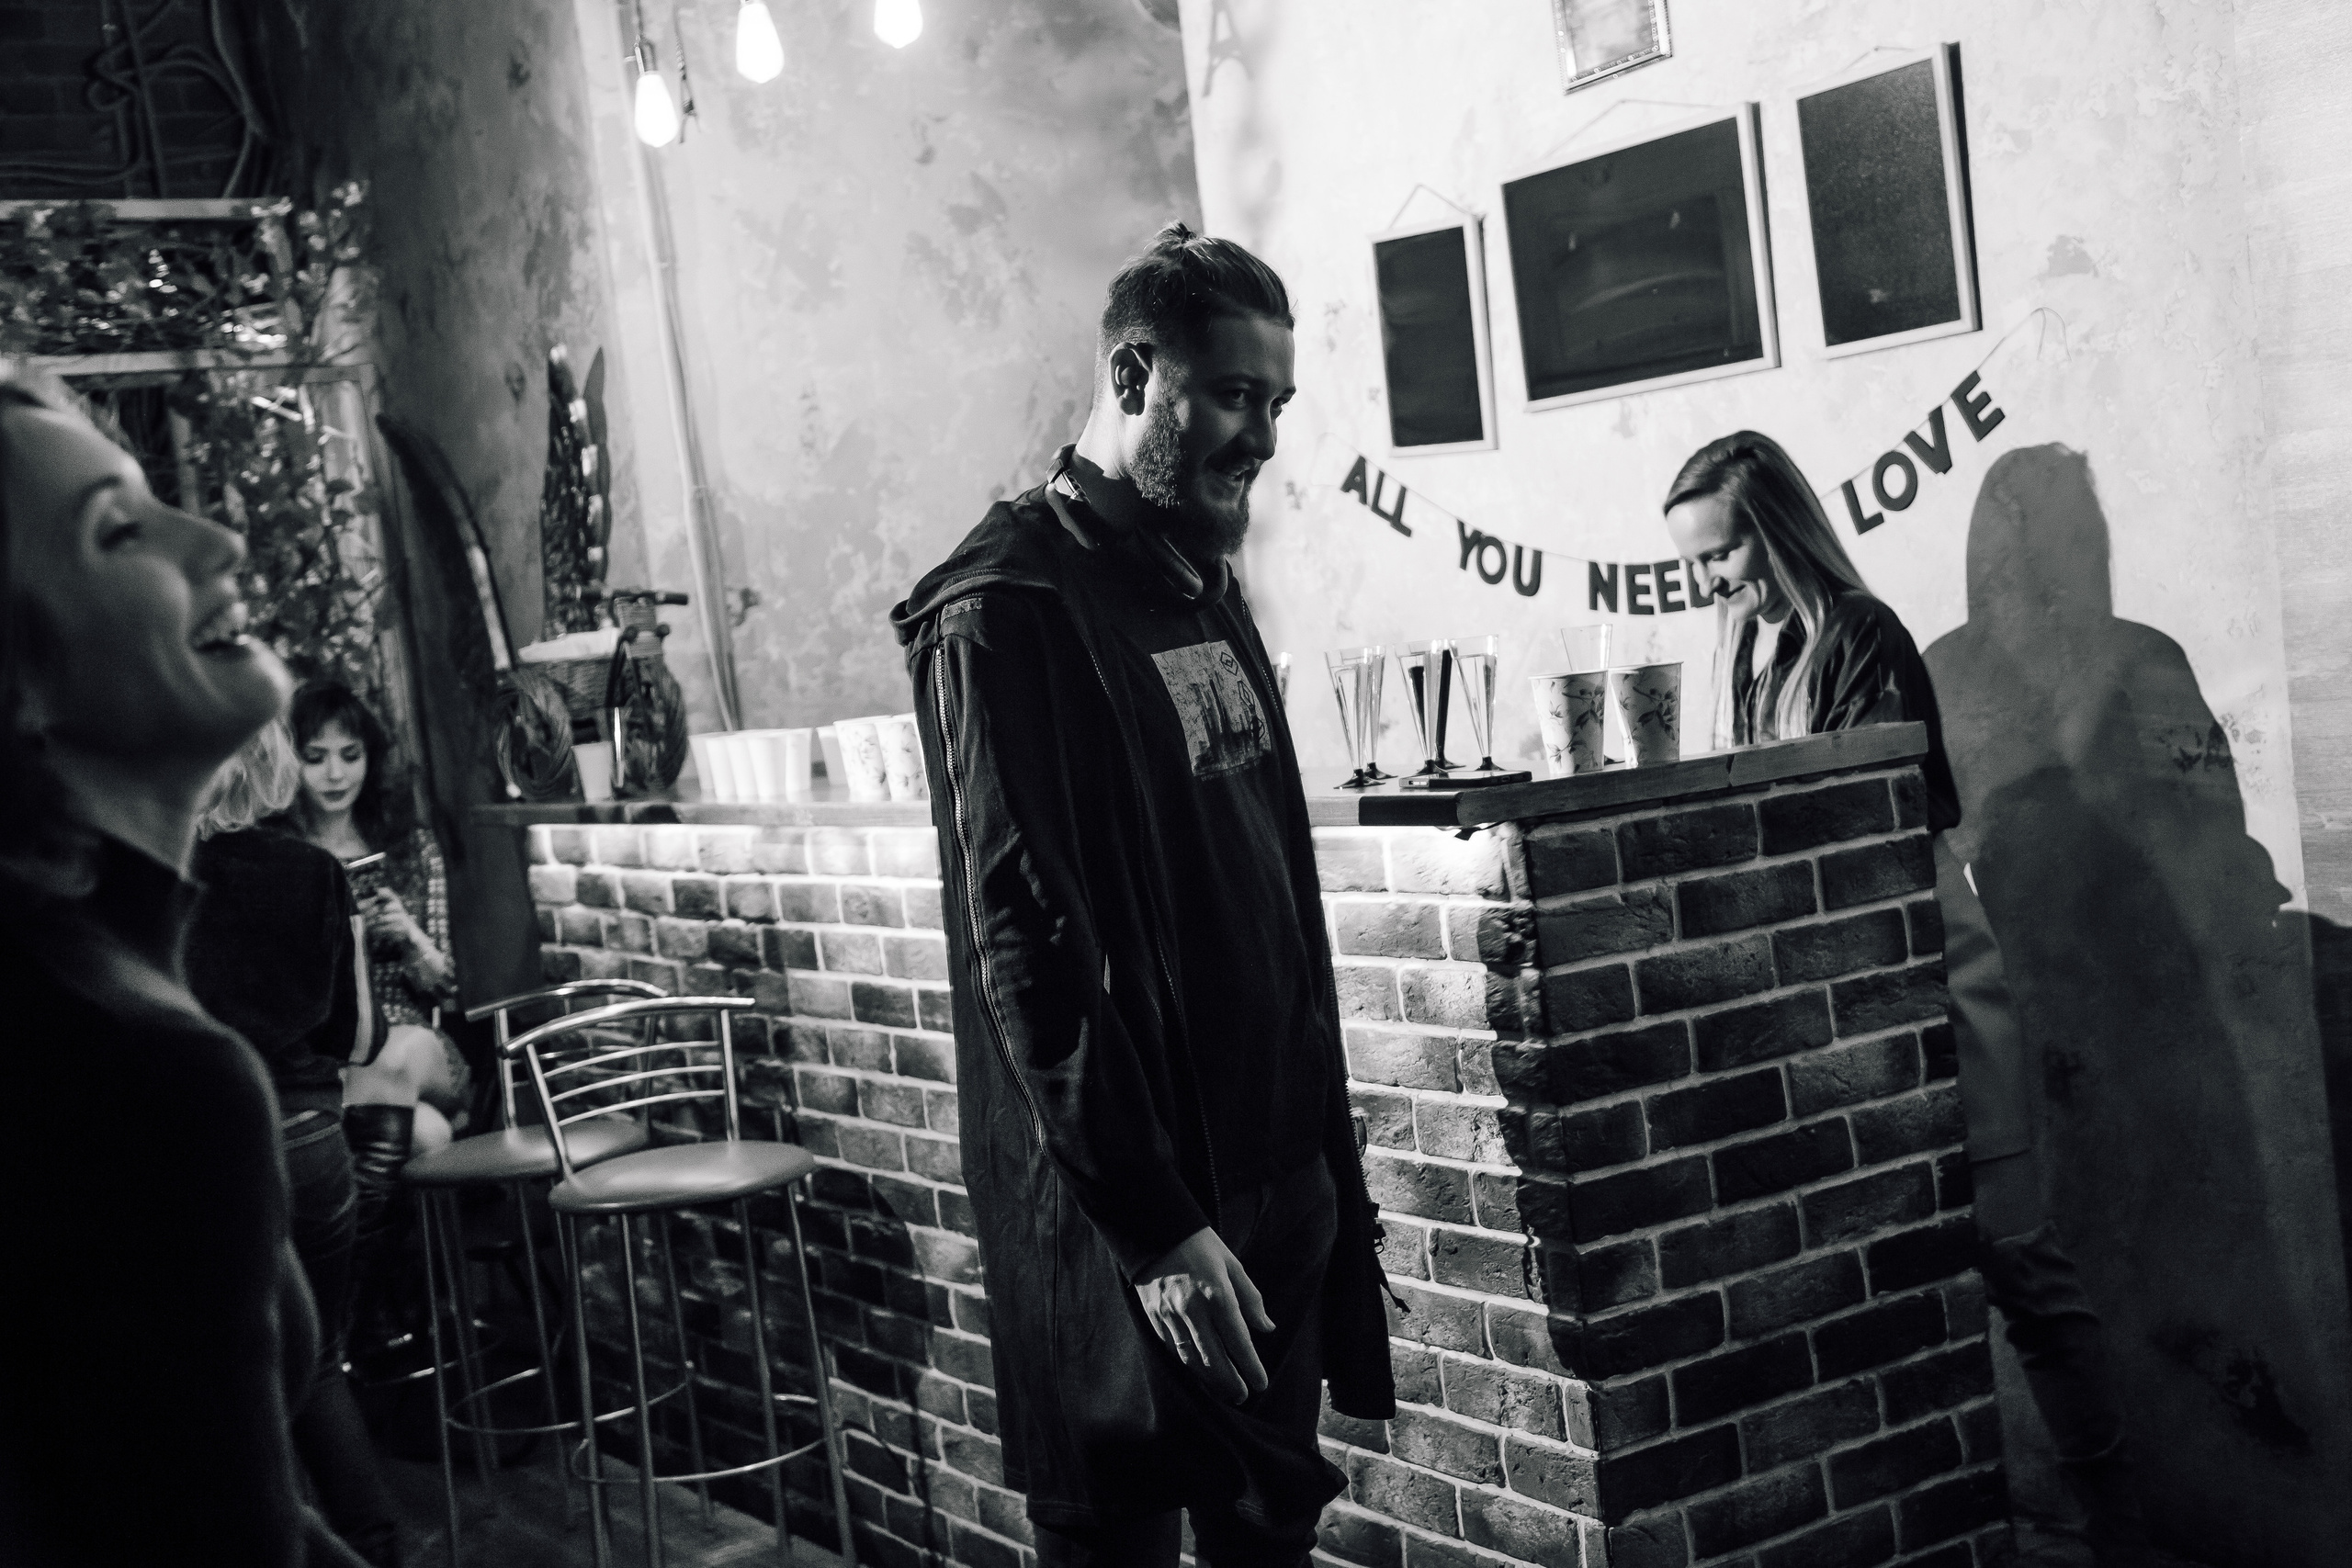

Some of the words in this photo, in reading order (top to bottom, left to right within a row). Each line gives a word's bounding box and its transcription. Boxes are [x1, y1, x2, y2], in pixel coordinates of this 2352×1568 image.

[1340, 455, 1413, 537] ALL
[1455, 517, 1543, 597] YOU
[1840, 369, 2007, 536] LOVE
